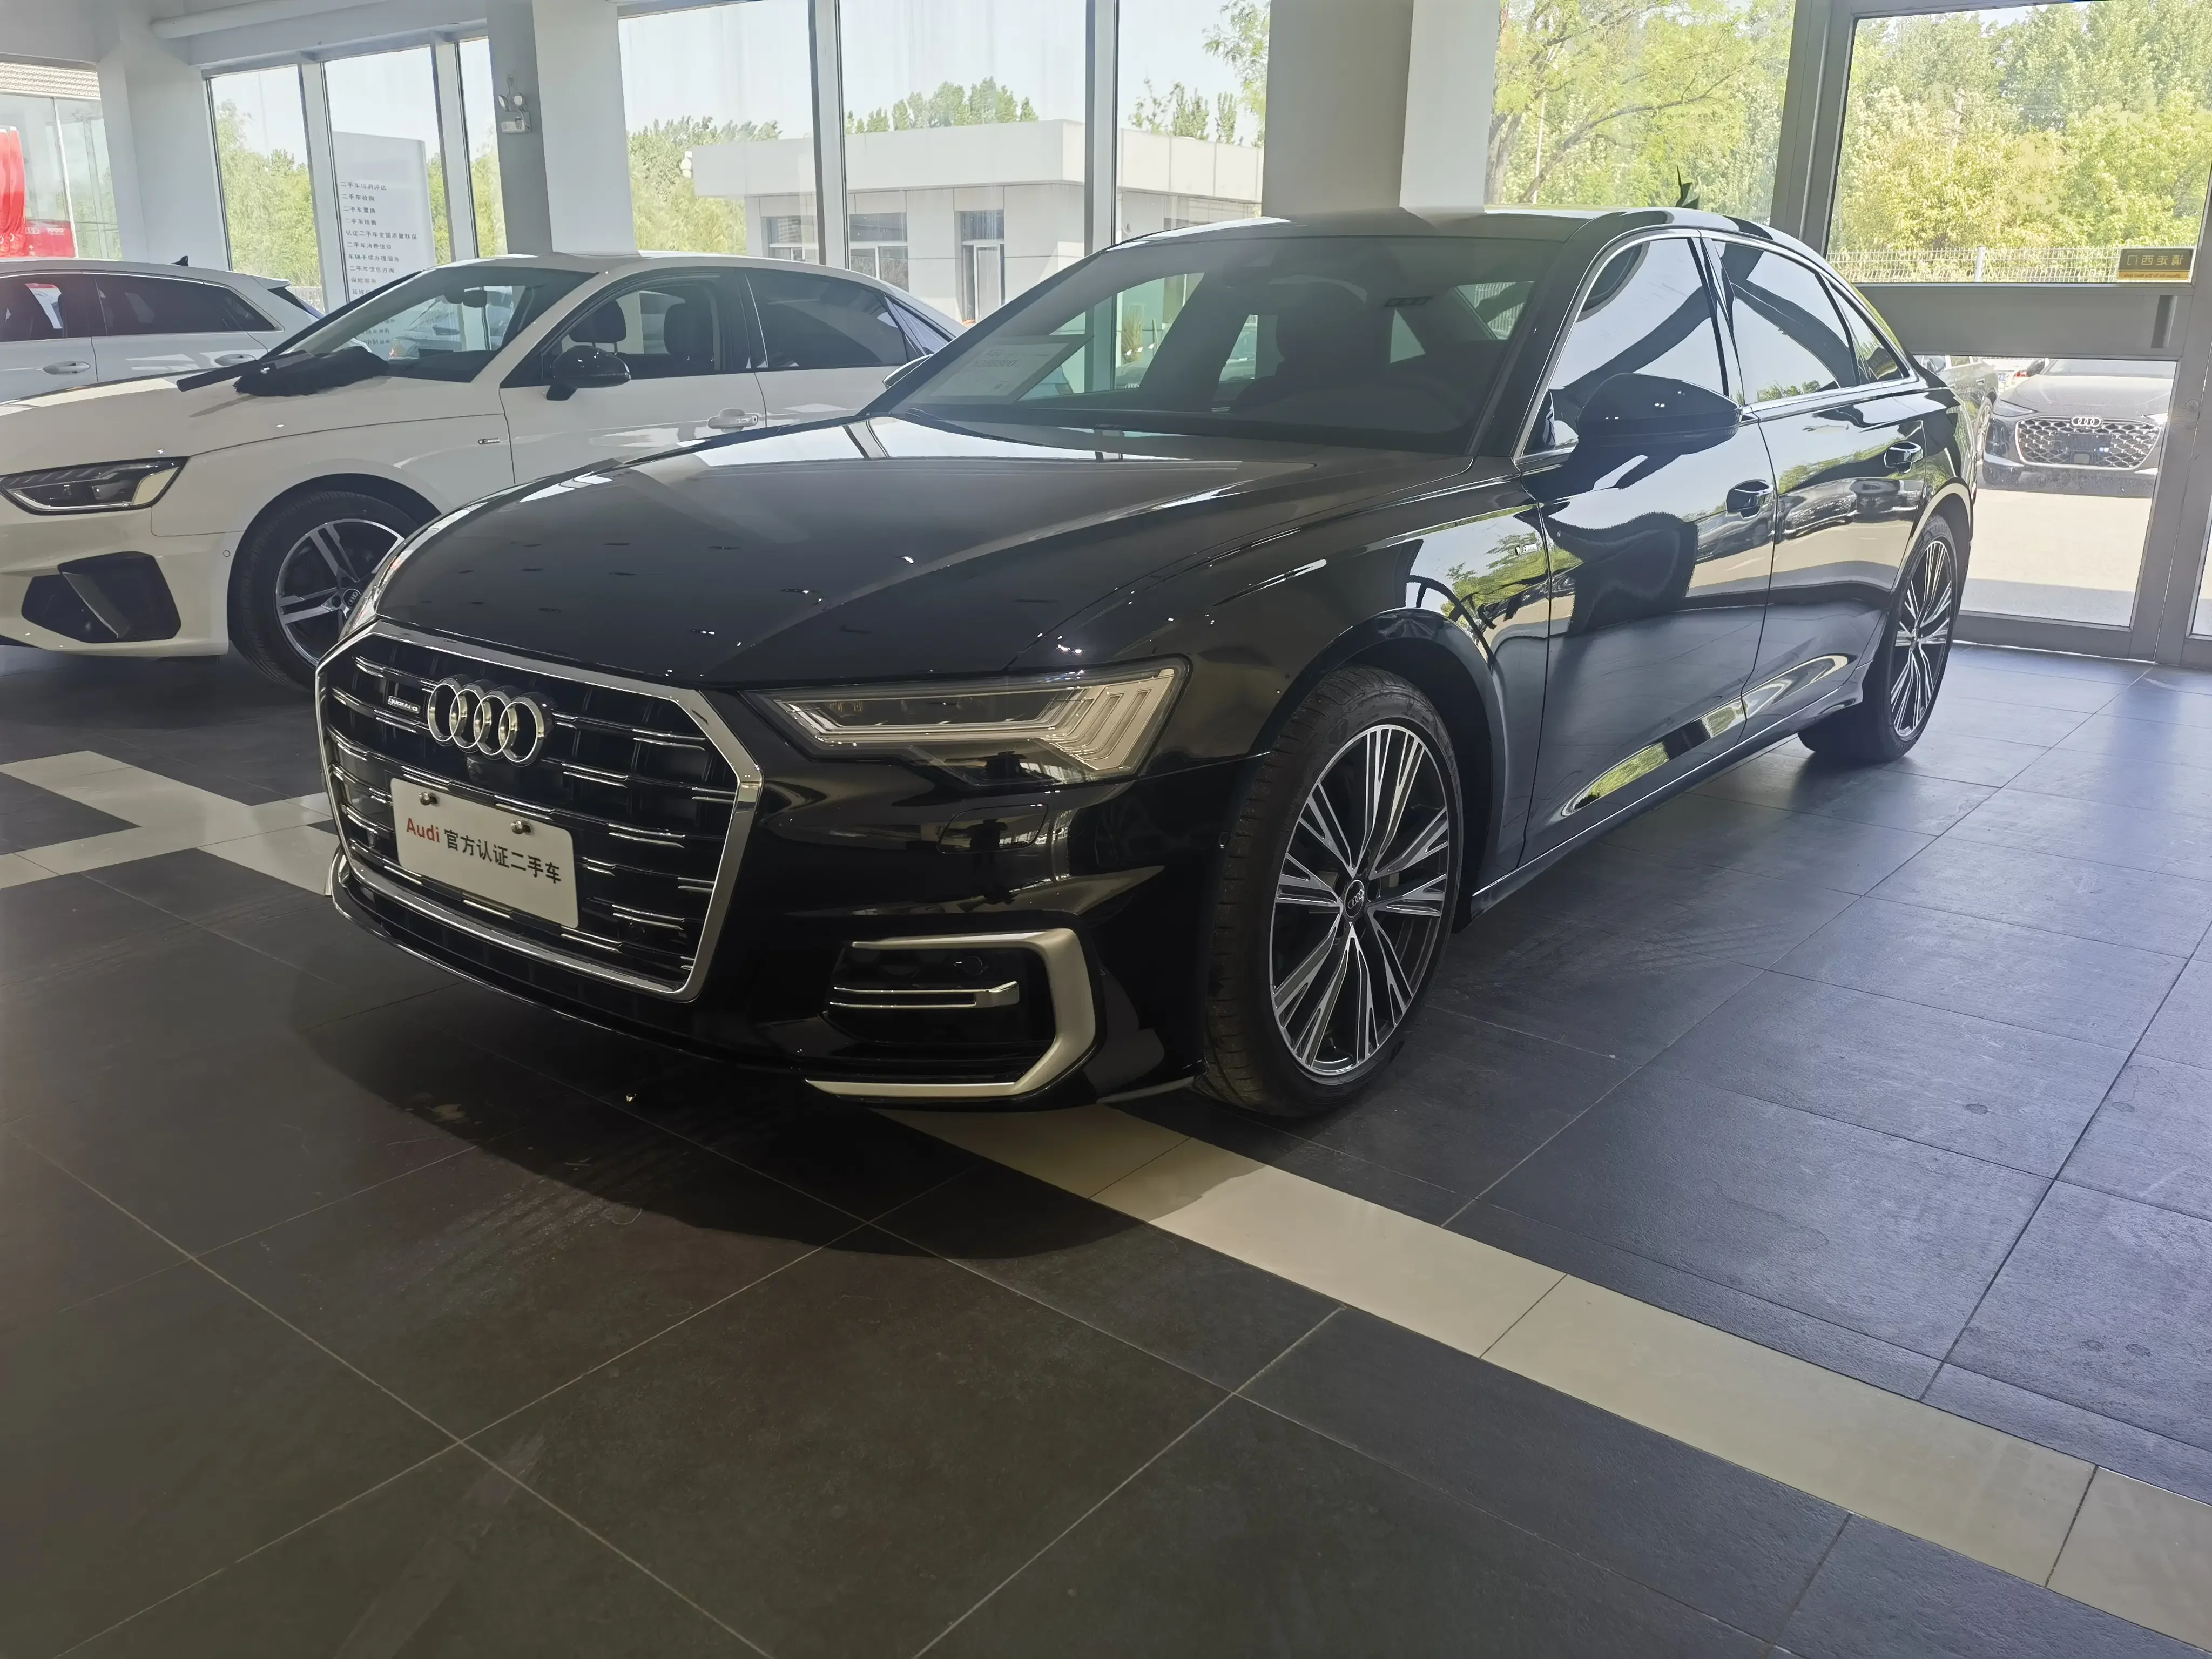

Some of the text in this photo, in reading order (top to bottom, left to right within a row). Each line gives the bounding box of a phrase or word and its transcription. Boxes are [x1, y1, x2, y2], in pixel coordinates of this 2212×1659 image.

[406, 818, 561, 884] Audi 官方认证二手车
